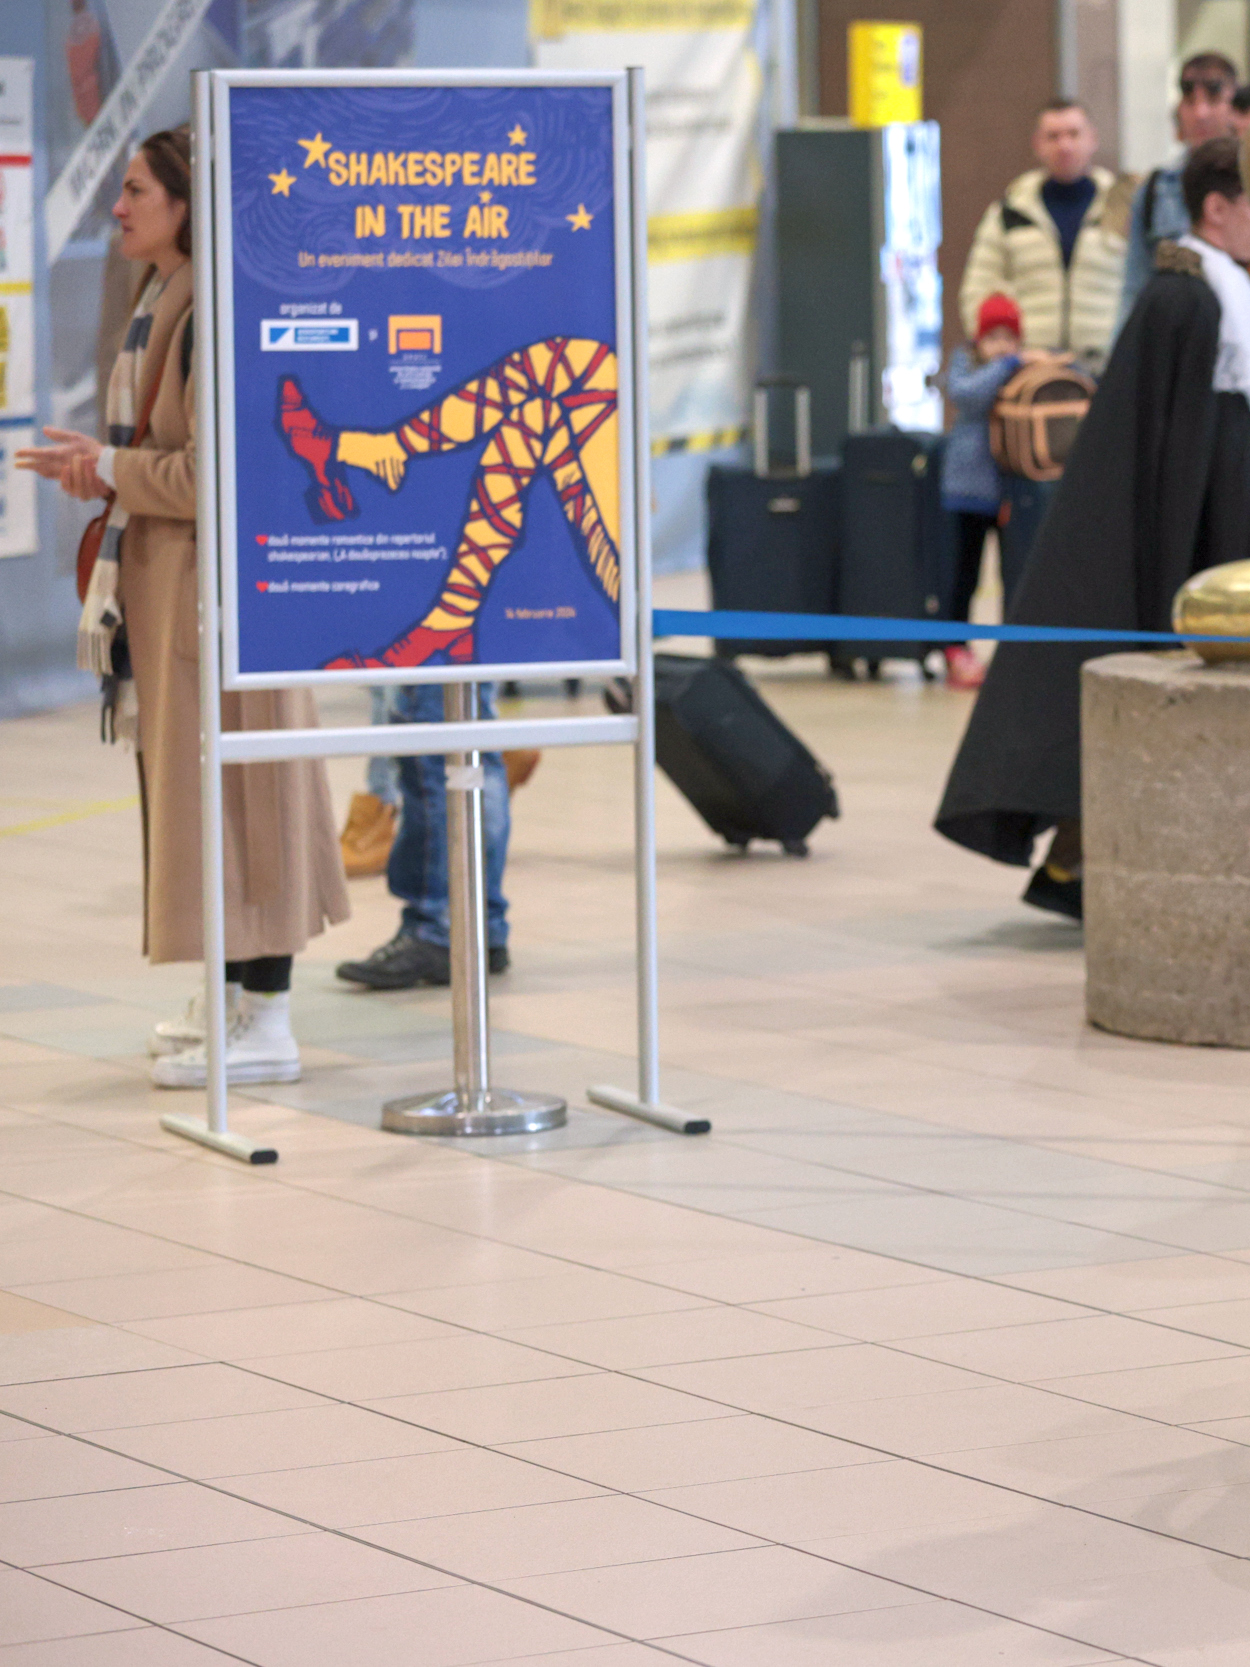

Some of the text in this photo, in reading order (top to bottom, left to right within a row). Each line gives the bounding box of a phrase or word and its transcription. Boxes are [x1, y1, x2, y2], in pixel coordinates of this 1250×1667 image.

[327, 151, 537, 187] SHAKESPEARE
[355, 203, 509, 239] IN THE AIR
[298, 252, 315, 267] Un
[318, 252, 384, 267] eveniment
[387, 251, 434, 267] dedicat
[437, 251, 463, 267] Zilei
[279, 302, 343, 317] organizat de
[290, 535, 330, 546] momente
[290, 581, 330, 593] momente
